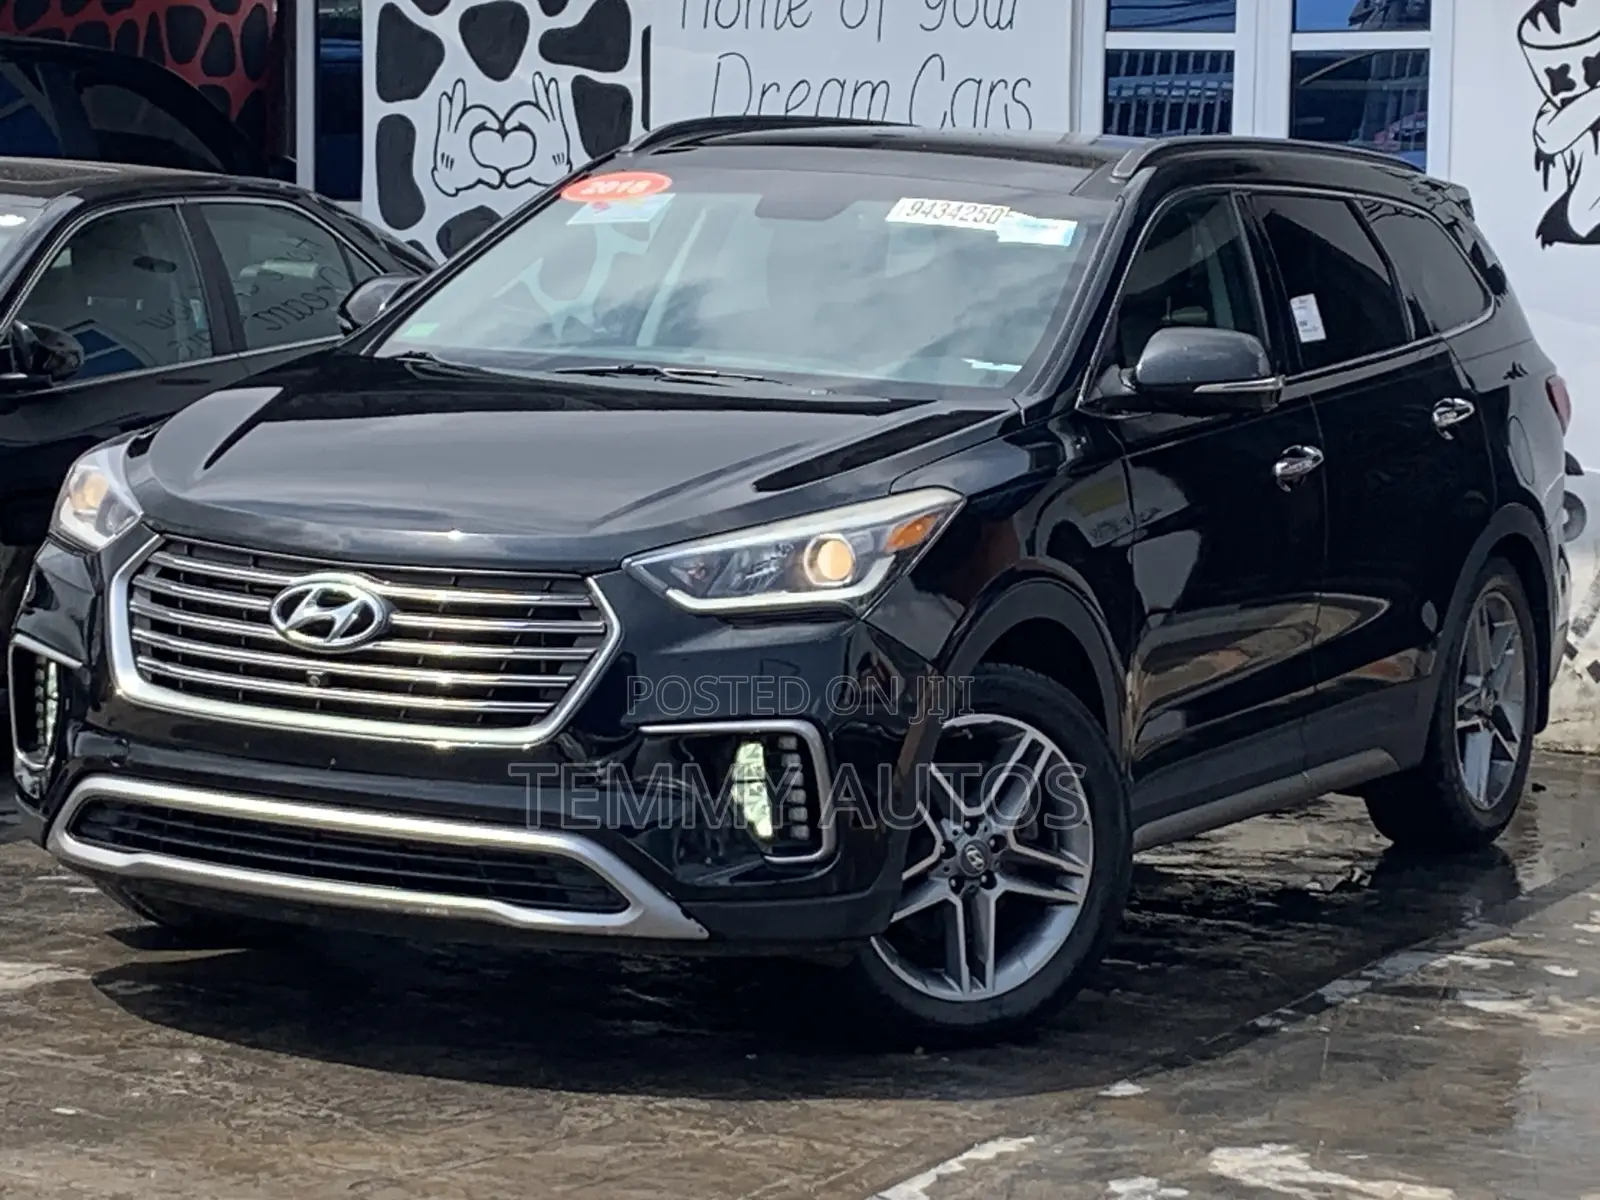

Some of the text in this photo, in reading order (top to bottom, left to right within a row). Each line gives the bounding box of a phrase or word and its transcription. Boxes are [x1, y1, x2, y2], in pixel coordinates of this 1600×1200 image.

[710, 52, 1033, 130] Dream Cars
[905, 200, 1015, 225] 9434250
